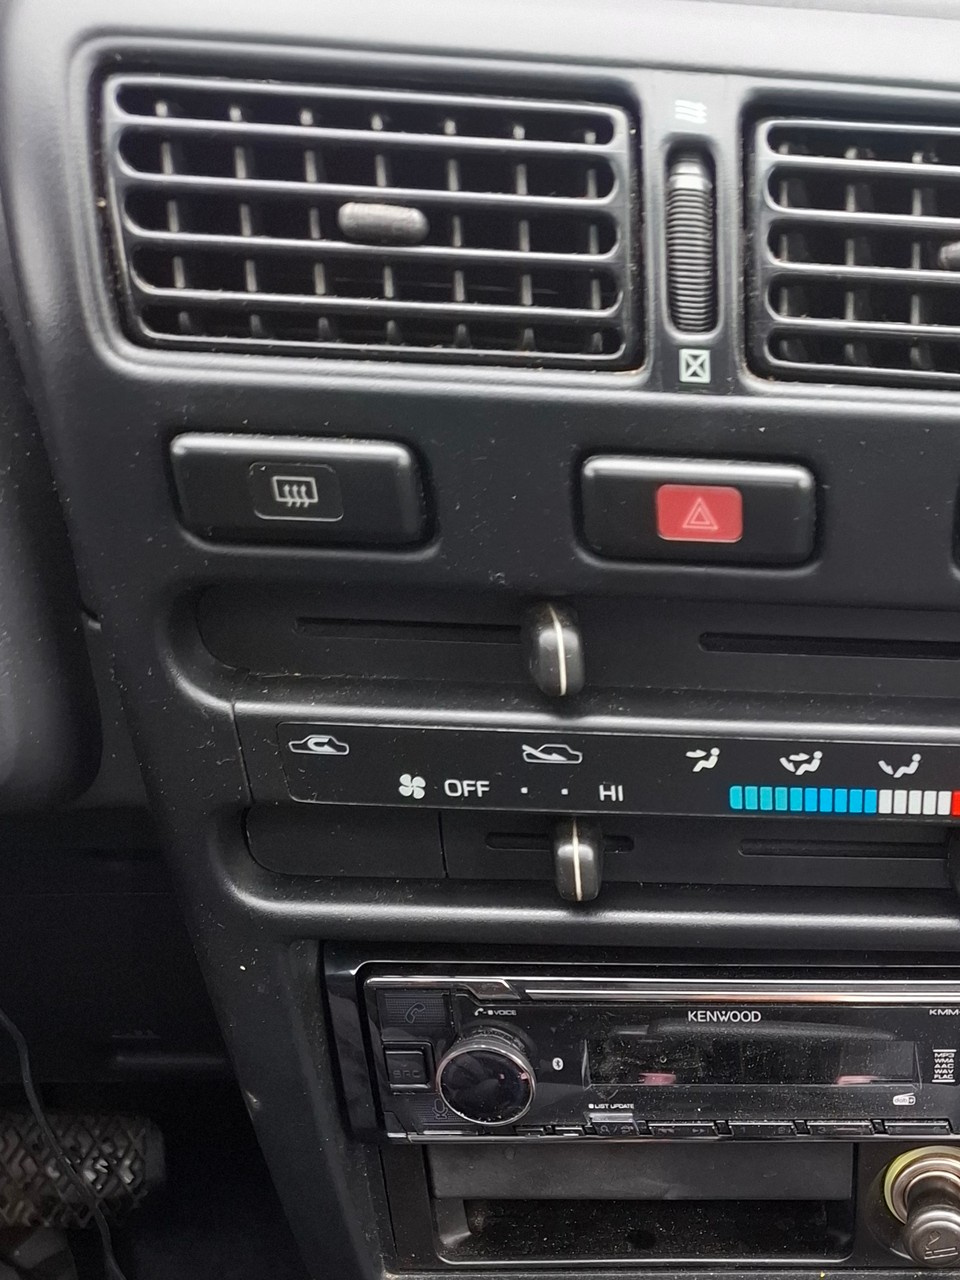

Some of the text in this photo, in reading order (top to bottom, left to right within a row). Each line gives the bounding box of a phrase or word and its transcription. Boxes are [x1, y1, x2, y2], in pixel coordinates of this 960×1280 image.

[444, 779, 624, 802] OFF HI
[687, 1010, 762, 1022] KENWOOD
